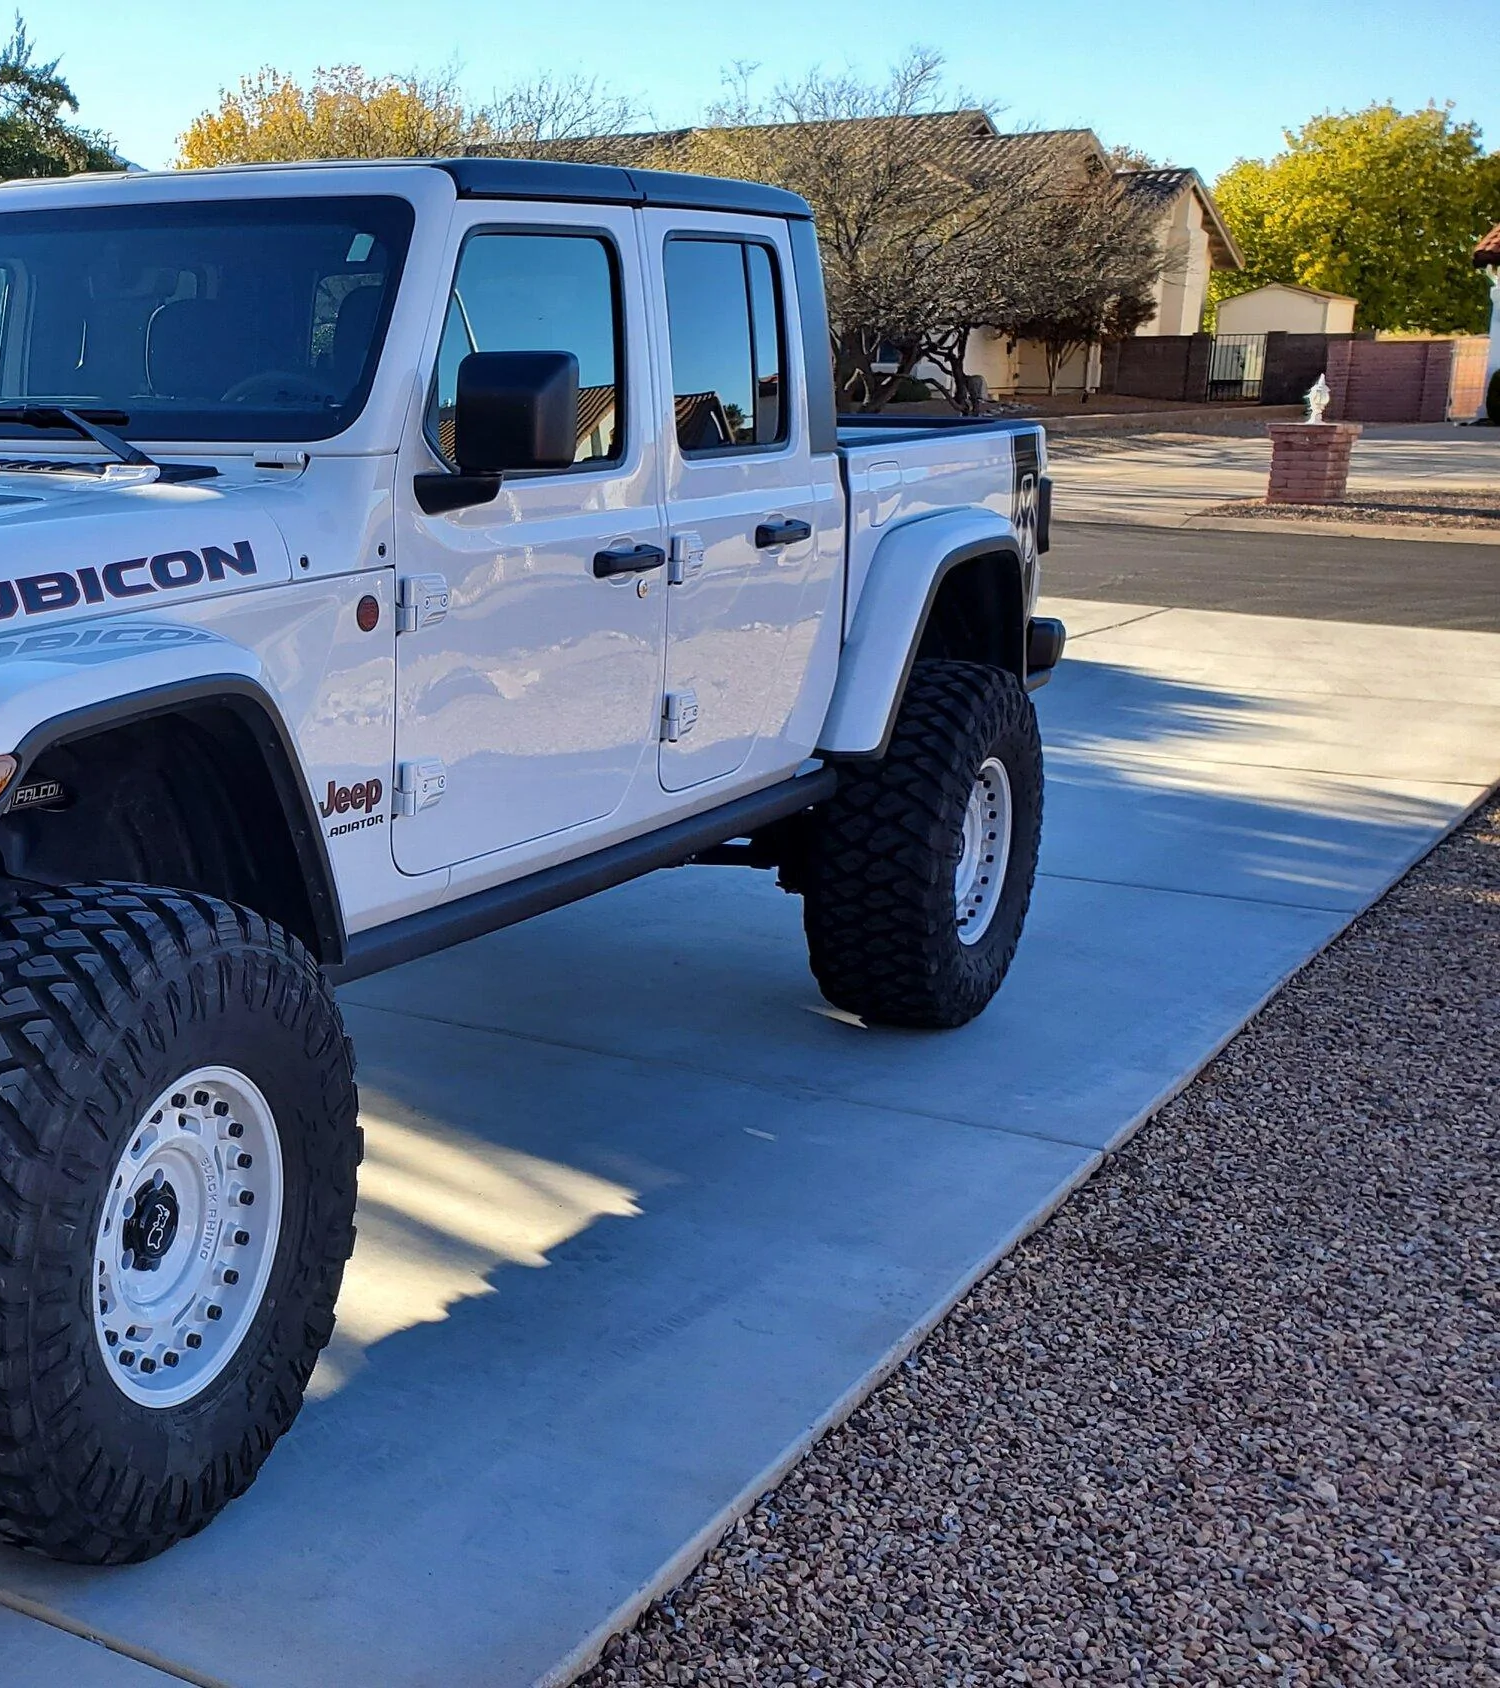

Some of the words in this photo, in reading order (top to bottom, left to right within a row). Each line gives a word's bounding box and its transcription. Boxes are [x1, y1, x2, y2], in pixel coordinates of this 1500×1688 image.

[318, 778, 383, 819] Jeep
[327, 814, 384, 838] ADIATOR
[200, 1156, 218, 1203] BLACK
[199, 1208, 217, 1261] RHINO
